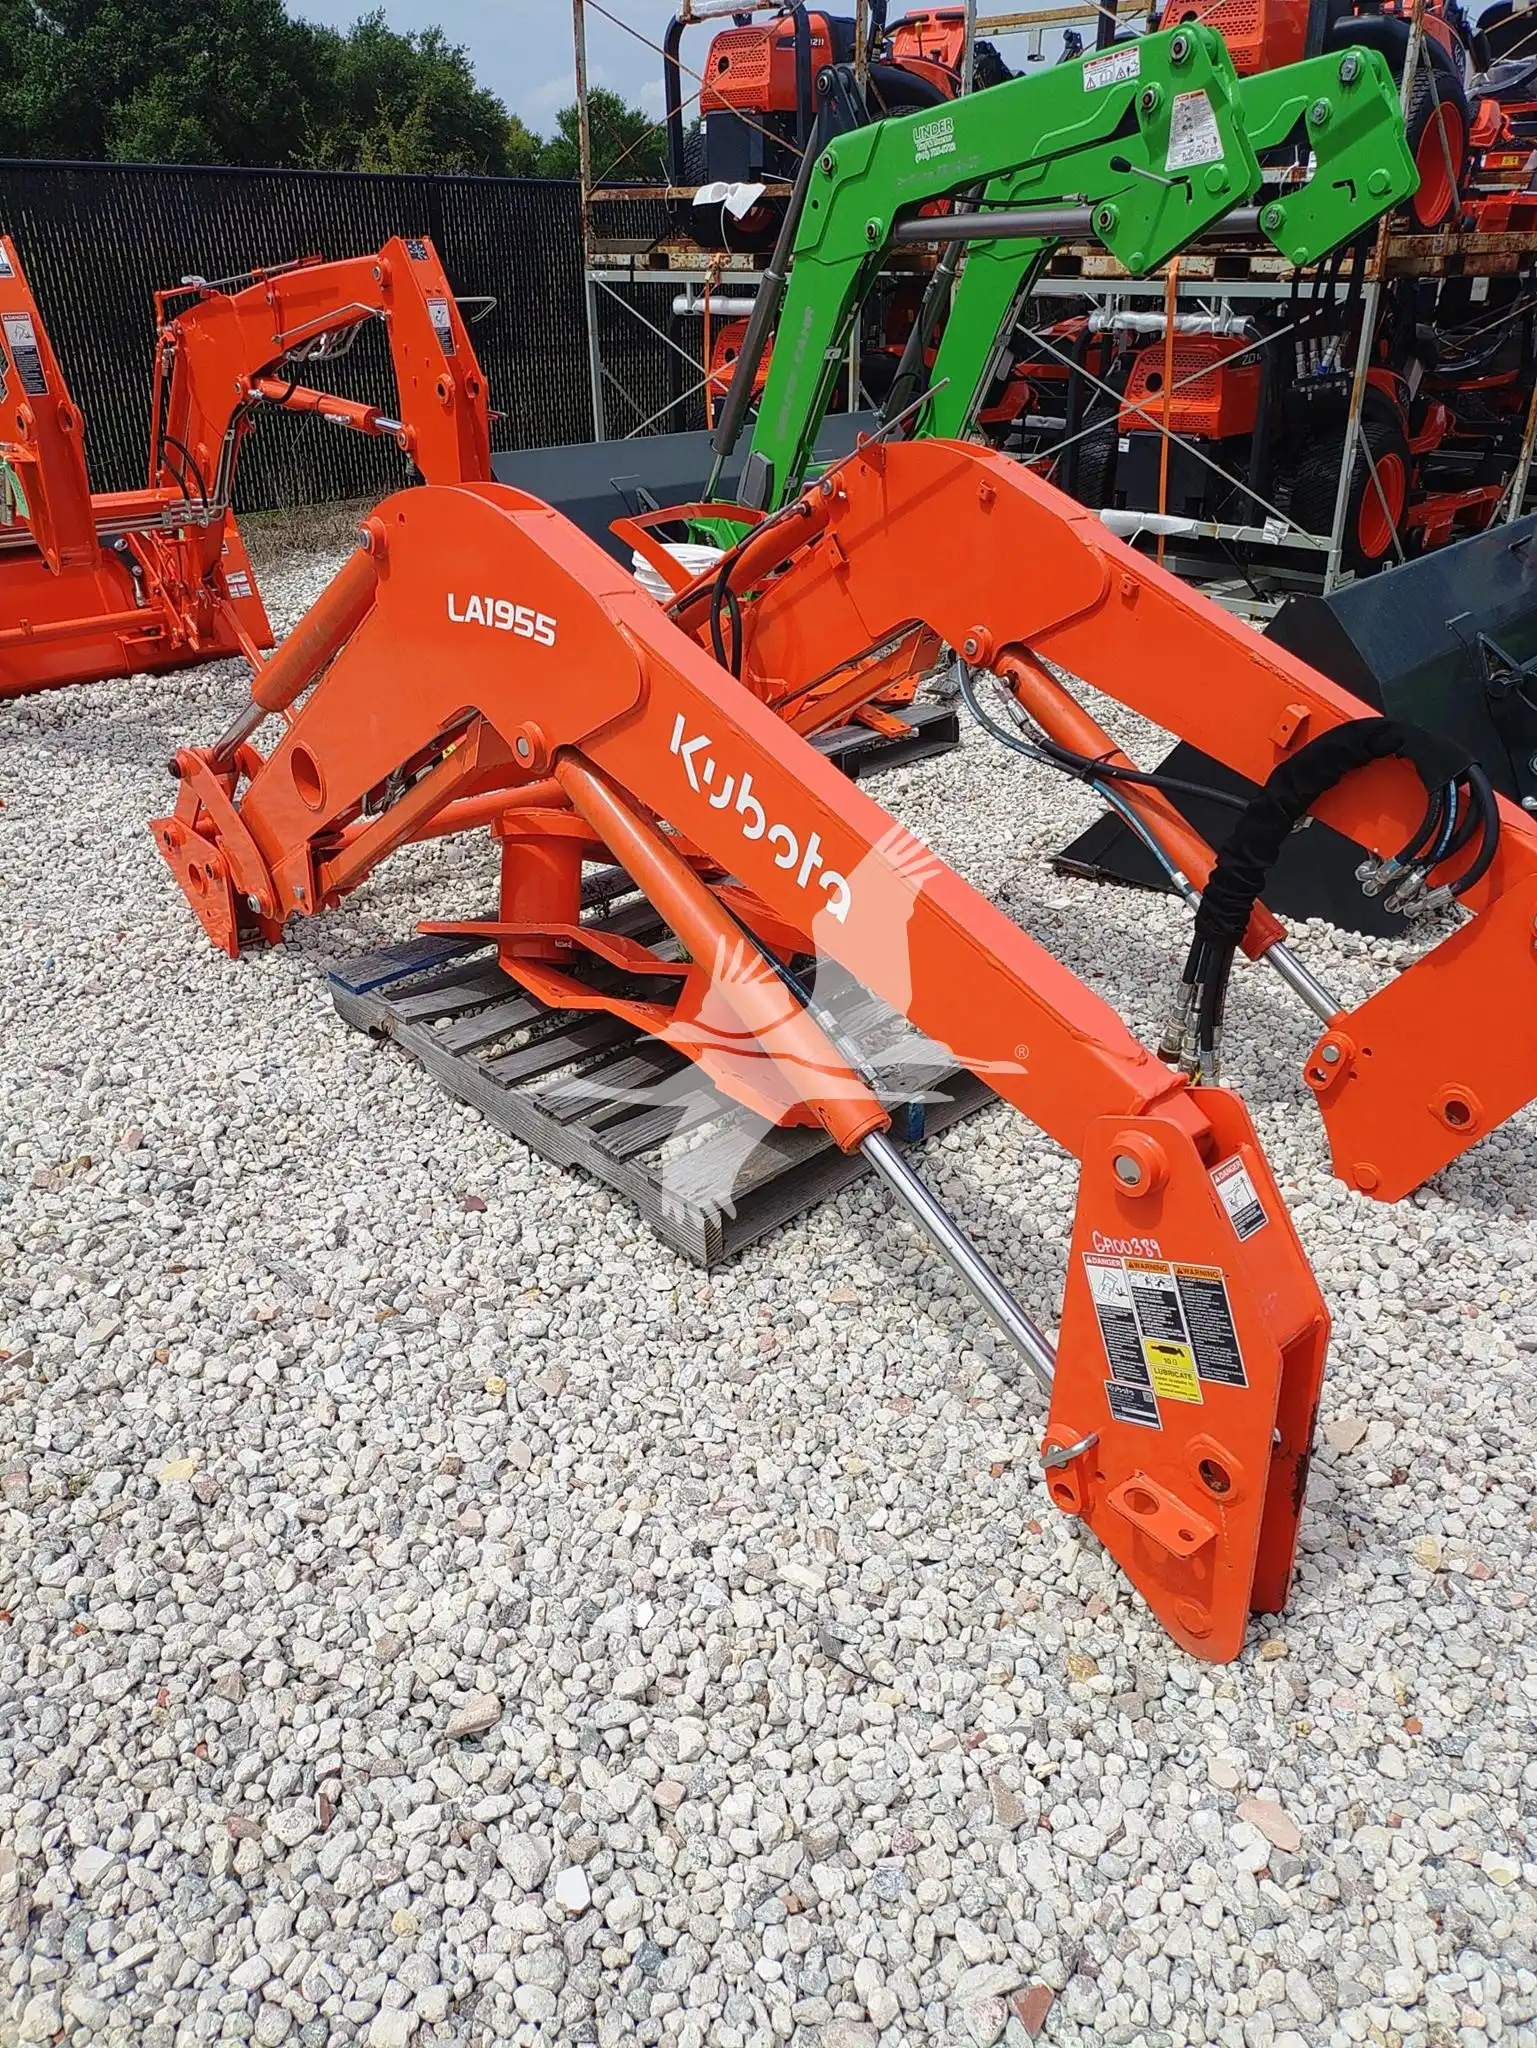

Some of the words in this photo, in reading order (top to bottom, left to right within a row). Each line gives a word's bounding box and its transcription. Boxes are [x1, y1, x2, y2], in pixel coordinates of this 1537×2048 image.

[913, 118, 954, 139] LINDER
[447, 592, 557, 647] LA1955
[669, 712, 852, 925] Kubota
[1219, 1160, 1241, 1179] DANGER
[1091, 1257, 1122, 1268] DANGER
[1133, 1262, 1168, 1273] WARNING
[1183, 1268, 1219, 1278] WARNING
[1153, 1367, 1193, 1380] LUBRICATE
